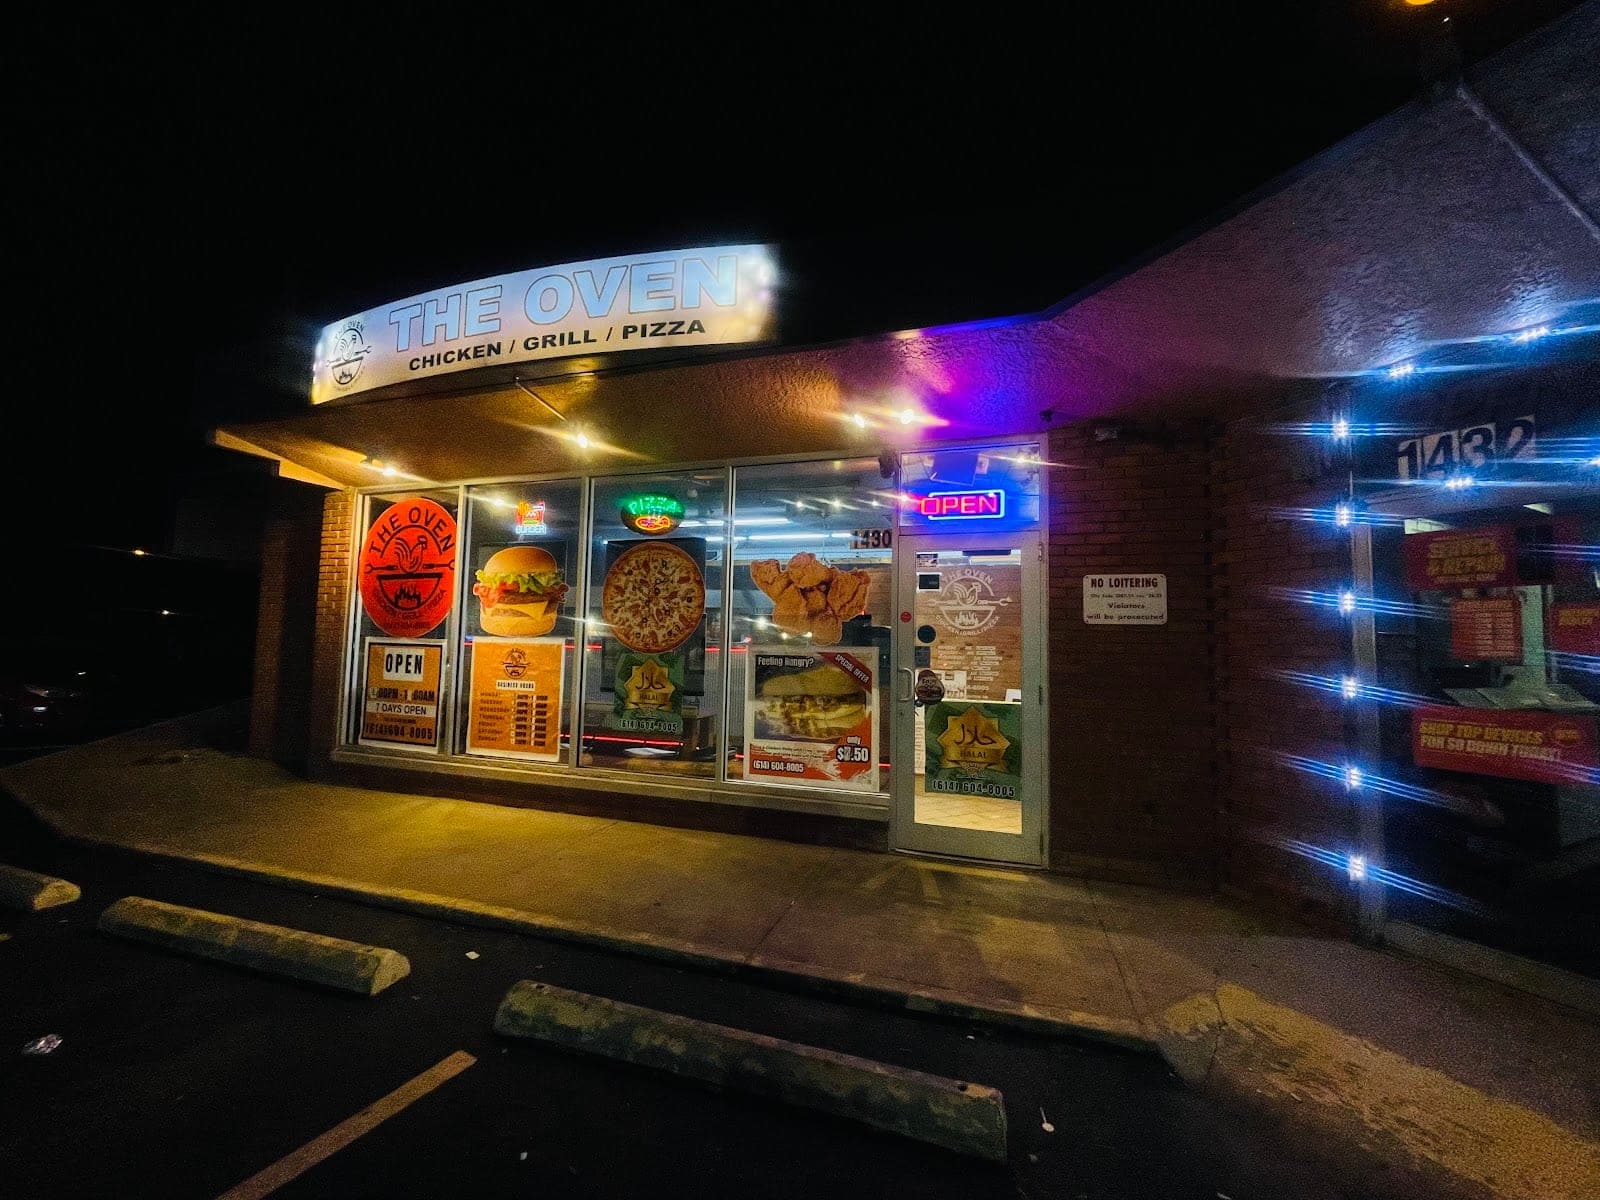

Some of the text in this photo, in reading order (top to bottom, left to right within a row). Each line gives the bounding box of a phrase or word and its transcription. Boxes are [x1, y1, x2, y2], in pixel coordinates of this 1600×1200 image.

[389, 255, 737, 352] THE OVEN
[409, 319, 706, 371] CHICKEN / GRILL / PIZZA
[920, 494, 997, 515] OPEN
[368, 506, 455, 554] THE OVEN
[853, 529, 892, 548] 1430
[964, 568, 994, 585] OVEN
[1091, 577, 1158, 588] NO LOITERING
[1118, 613, 1164, 621] prosecuted
[385, 653, 422, 674] OPEN
[757, 656, 815, 668] Feeling Hungry?
[636, 672, 666, 690] حلال
[853, 668, 870, 684] OFFER
[376, 702, 427, 715] 7 DAYS OPEN
[954, 723, 997, 746] حلال
[1456, 724, 1483, 738] TOP
[752, 760, 805, 773] (614) 604-8005
[933, 780, 1015, 797] (614) 604-8005
